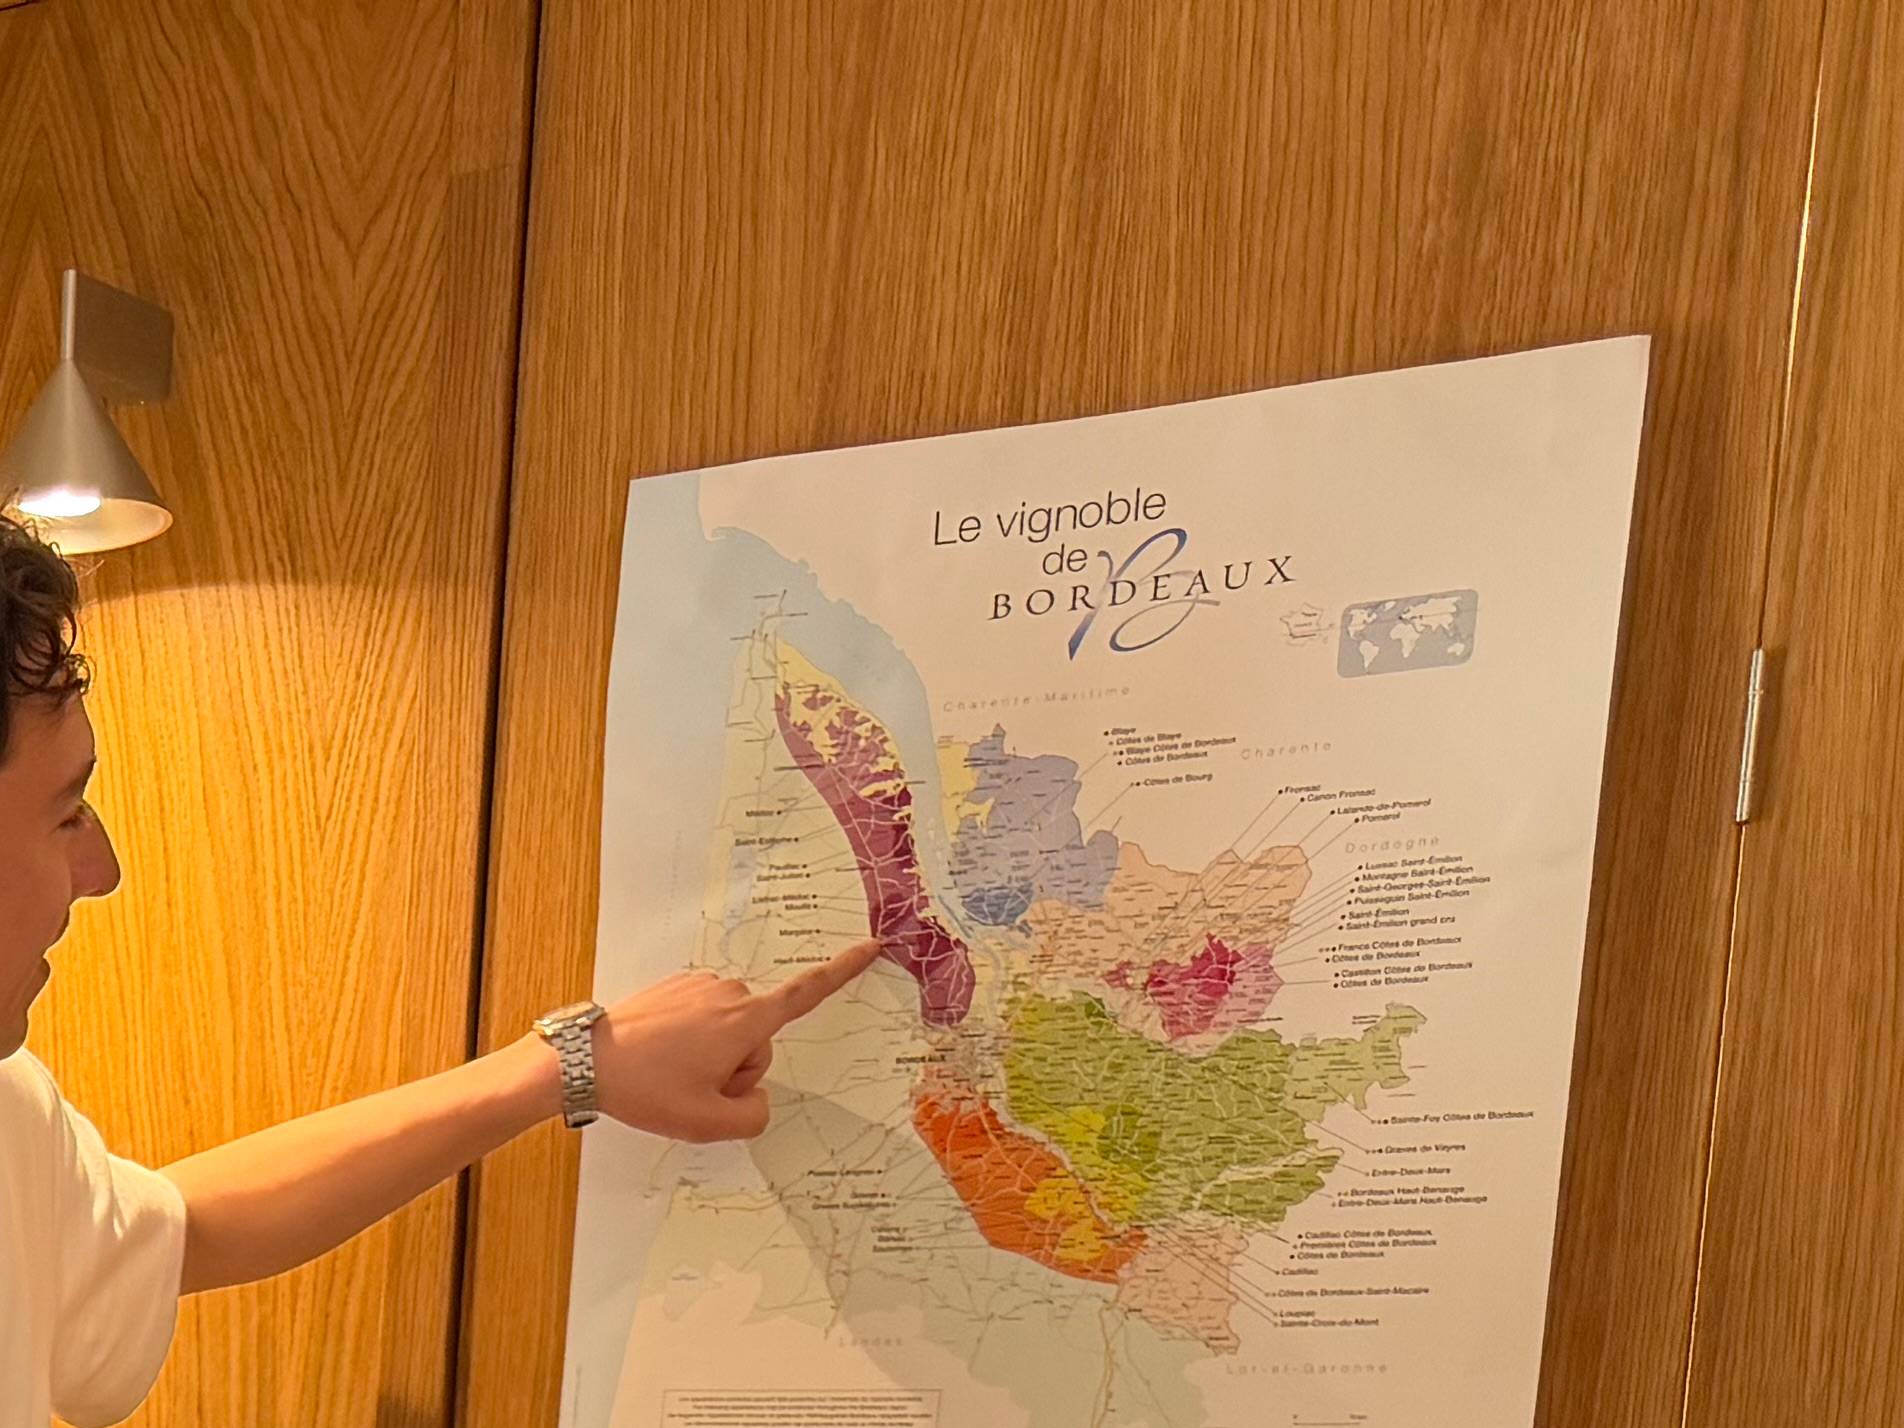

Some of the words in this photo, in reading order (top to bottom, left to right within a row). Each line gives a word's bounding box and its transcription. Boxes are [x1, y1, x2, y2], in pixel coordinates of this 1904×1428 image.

[933, 511, 981, 545] Le
[997, 487, 1166, 543] vignoble
[1042, 543, 1087, 575] de
[988, 556, 1296, 621] BORDEAUX
